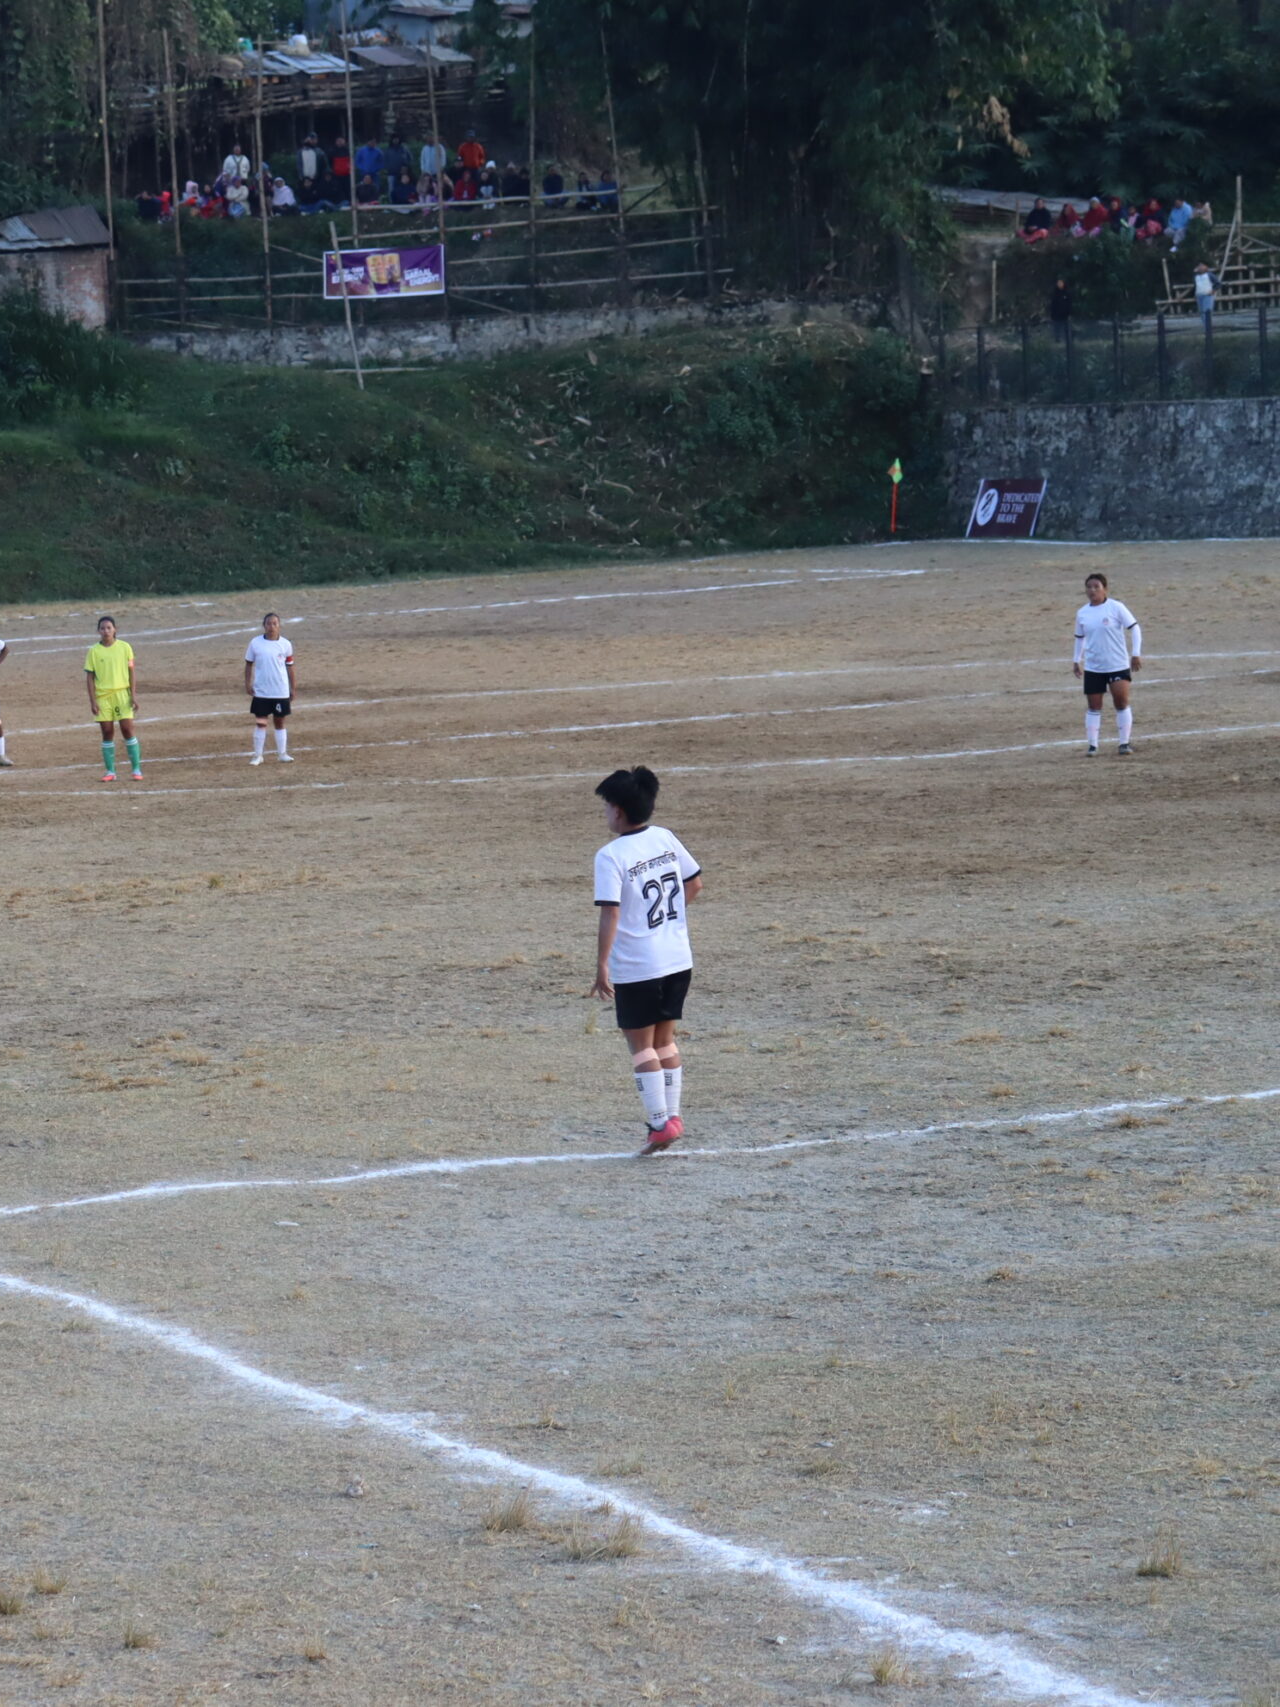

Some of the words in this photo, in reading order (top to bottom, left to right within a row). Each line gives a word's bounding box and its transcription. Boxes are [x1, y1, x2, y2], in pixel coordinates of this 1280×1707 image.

[1000, 503, 1010, 513] TO
[1011, 503, 1025, 513] THE
[642, 871, 680, 930] 27
